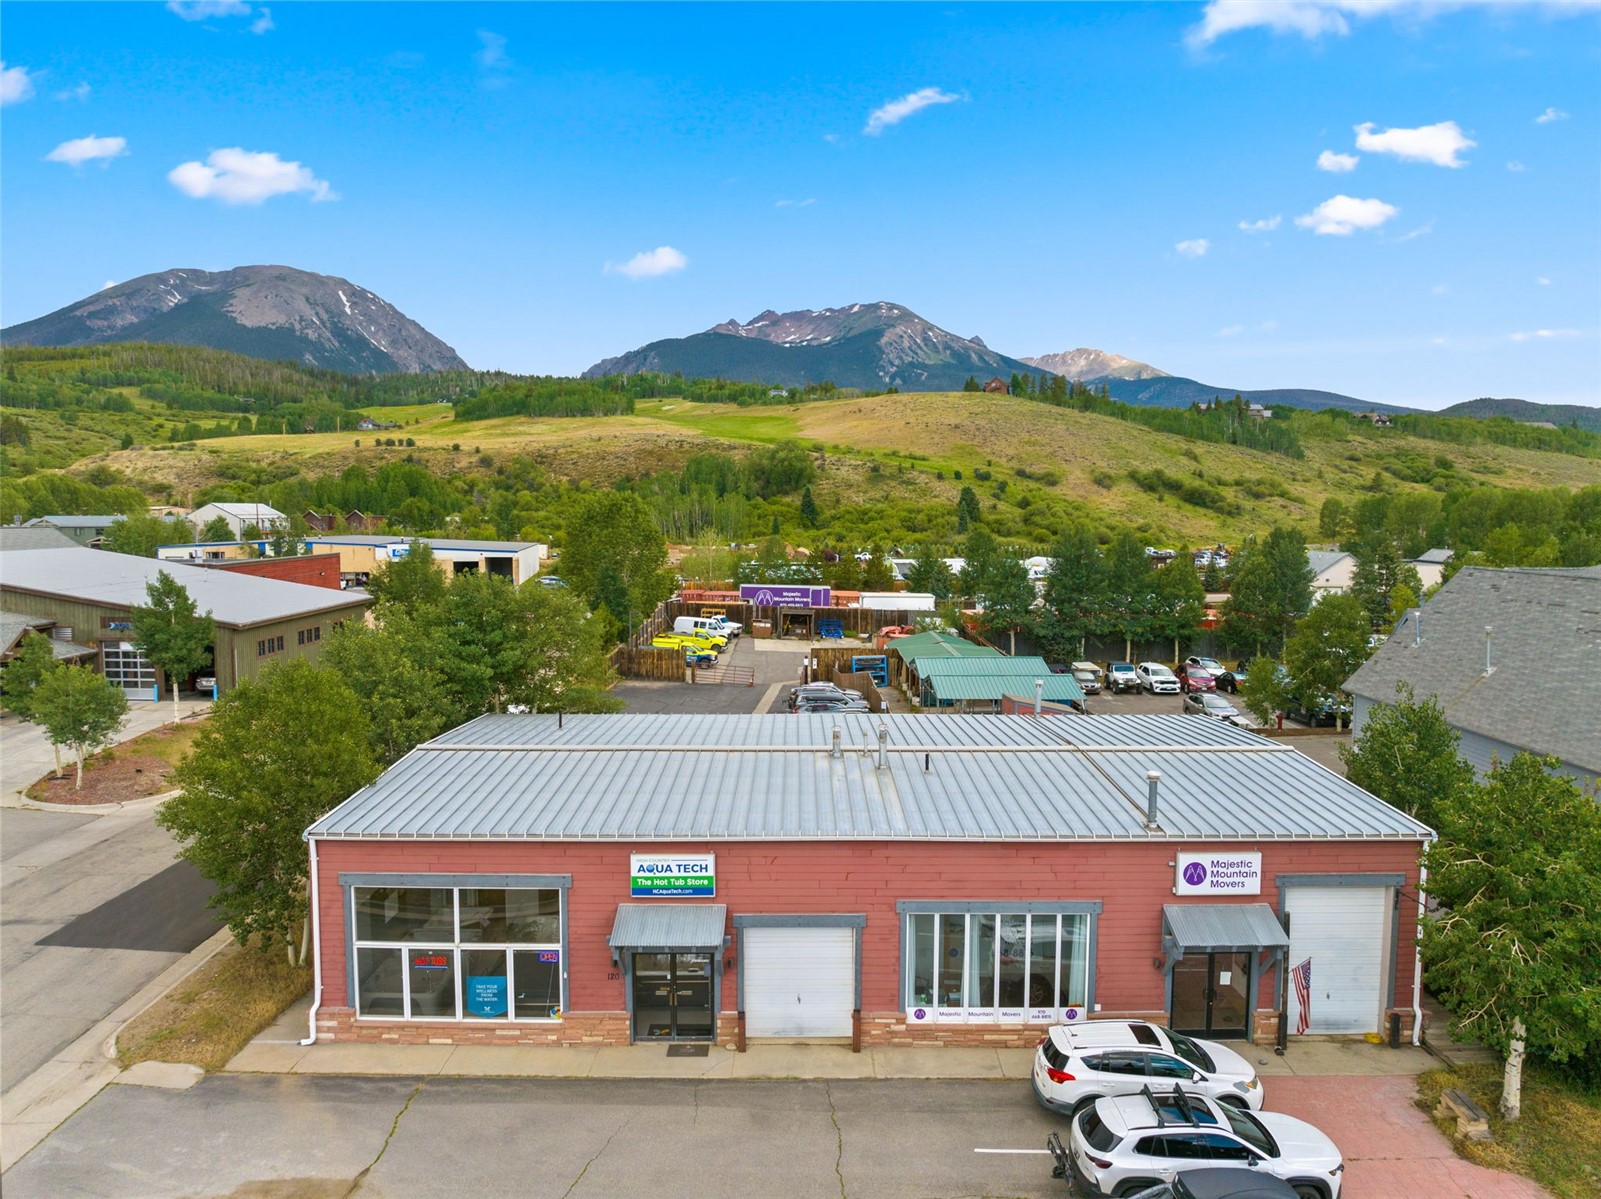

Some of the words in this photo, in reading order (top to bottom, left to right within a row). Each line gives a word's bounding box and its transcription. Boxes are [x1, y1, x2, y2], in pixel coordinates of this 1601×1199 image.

[637, 864, 673, 874] AQUA
[676, 864, 708, 873] TECH
[1211, 860, 1253, 870] Majestic
[1210, 870, 1258, 878] Mountain
[637, 878, 651, 886] The
[654, 878, 668, 886] Hot
[670, 878, 685, 886] Tub
[687, 878, 708, 886] Store
[1210, 880, 1246, 888] Movers
[541, 953, 557, 961] OPEN
